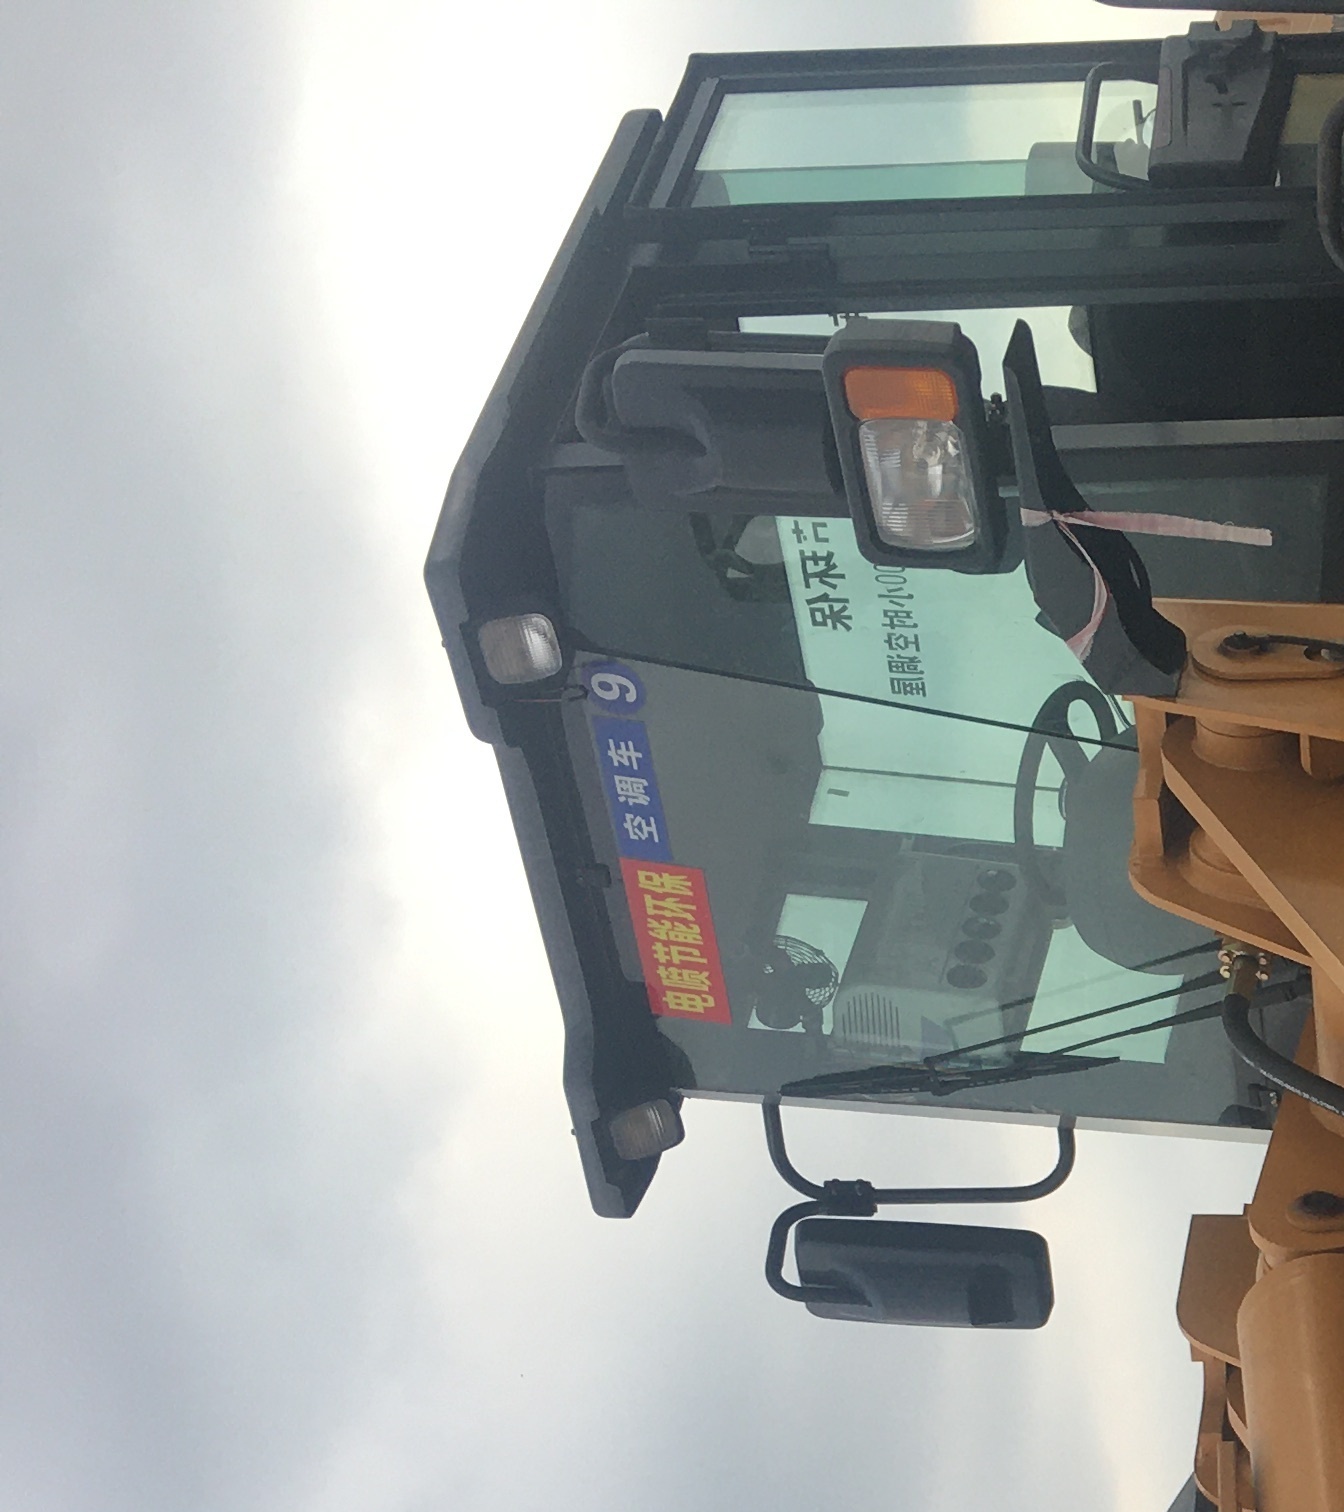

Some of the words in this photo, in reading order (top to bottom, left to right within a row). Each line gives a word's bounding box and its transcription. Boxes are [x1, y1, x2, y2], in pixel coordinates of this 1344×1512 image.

[590, 672, 637, 703] 9
[608, 738, 659, 844] 空调车
[637, 869, 715, 1014] 电喷节能环保
